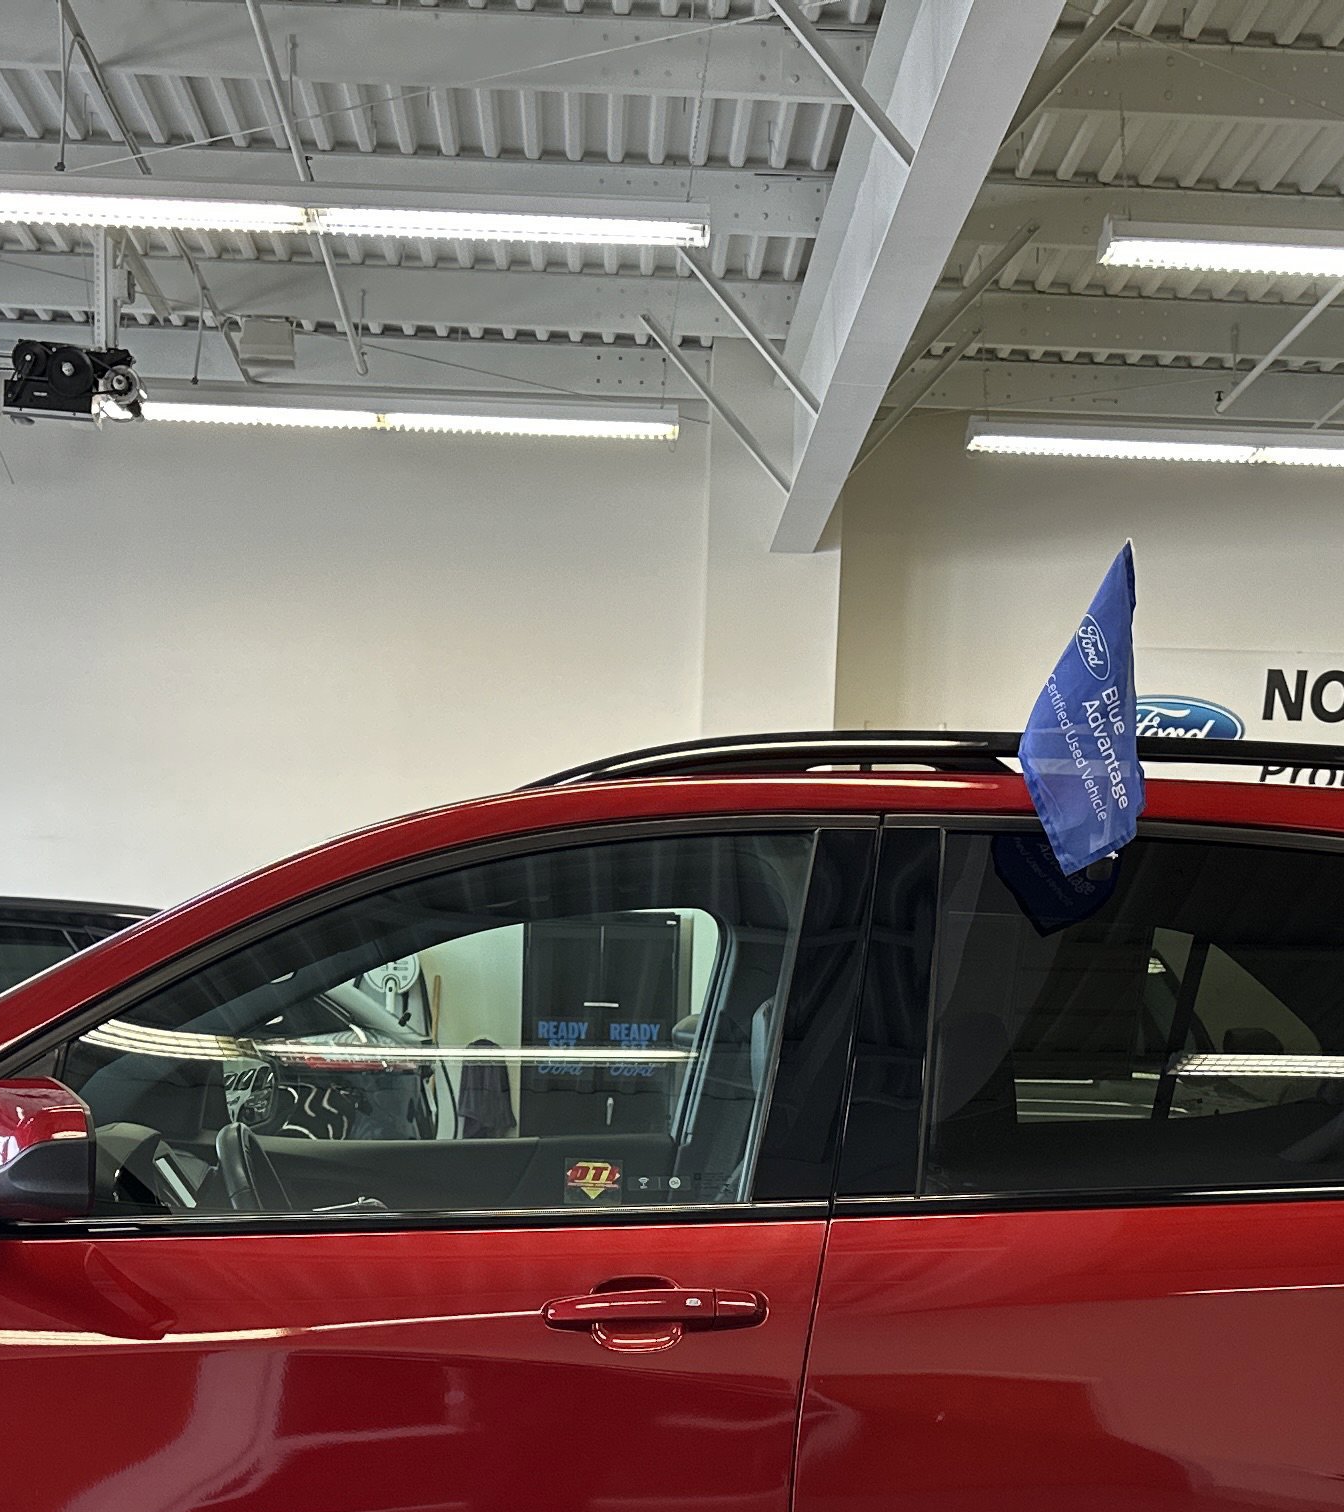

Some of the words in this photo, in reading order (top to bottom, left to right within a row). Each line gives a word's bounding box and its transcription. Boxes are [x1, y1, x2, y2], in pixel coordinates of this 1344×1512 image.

[1101, 685, 1126, 736] Blue
[1045, 673, 1074, 730] Certified
[1064, 730, 1089, 769] Used
[1081, 767, 1107, 822] Vehicle
[1081, 699, 1129, 810] Advantage
[538, 1020, 589, 1040] READY
[609, 1023, 661, 1041] READY
